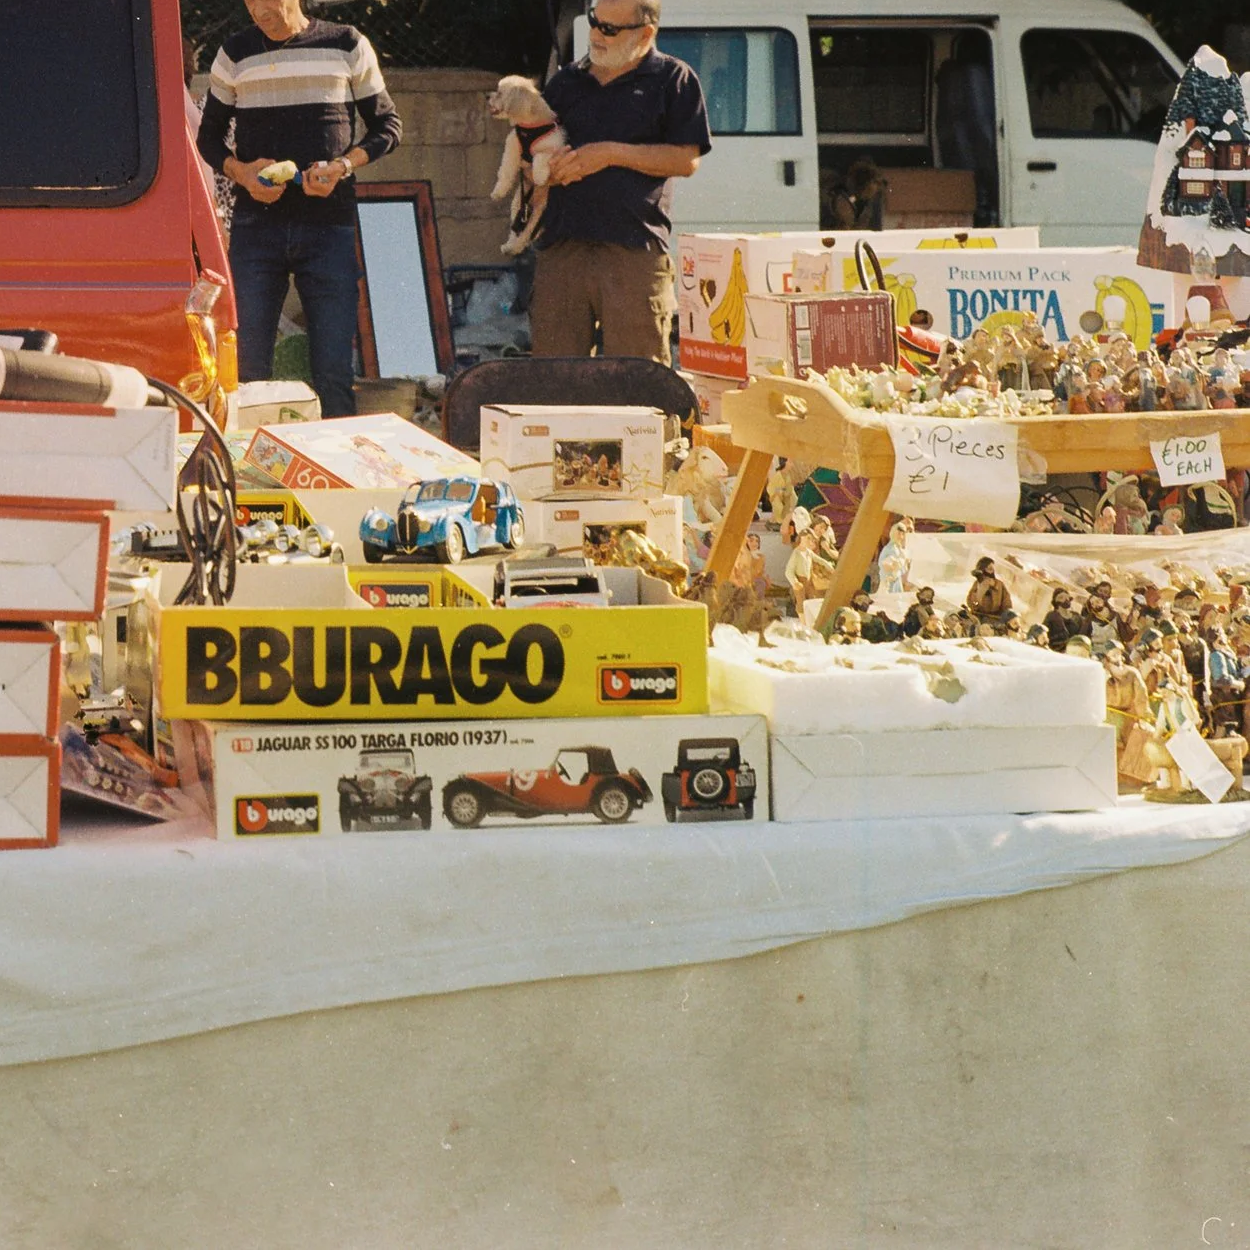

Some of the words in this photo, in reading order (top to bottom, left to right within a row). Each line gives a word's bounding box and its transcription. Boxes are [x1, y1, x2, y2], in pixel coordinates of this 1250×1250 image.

[948, 266, 1022, 282] PREMIUM
[1028, 266, 1071, 282] PACK
[946, 288, 1070, 343] BONITA
[928, 425, 1005, 459] Pieces
[1177, 457, 1212, 476] EACH
[186, 623, 564, 707] BBURAGO
[603, 670, 676, 698] burago
[256, 737, 311, 751] JAGUAR
[361, 734, 406, 748] TARGA
[410, 732, 458, 747] FLORIO
[463, 729, 507, 747] (1937)
[239, 800, 317, 831] burago
